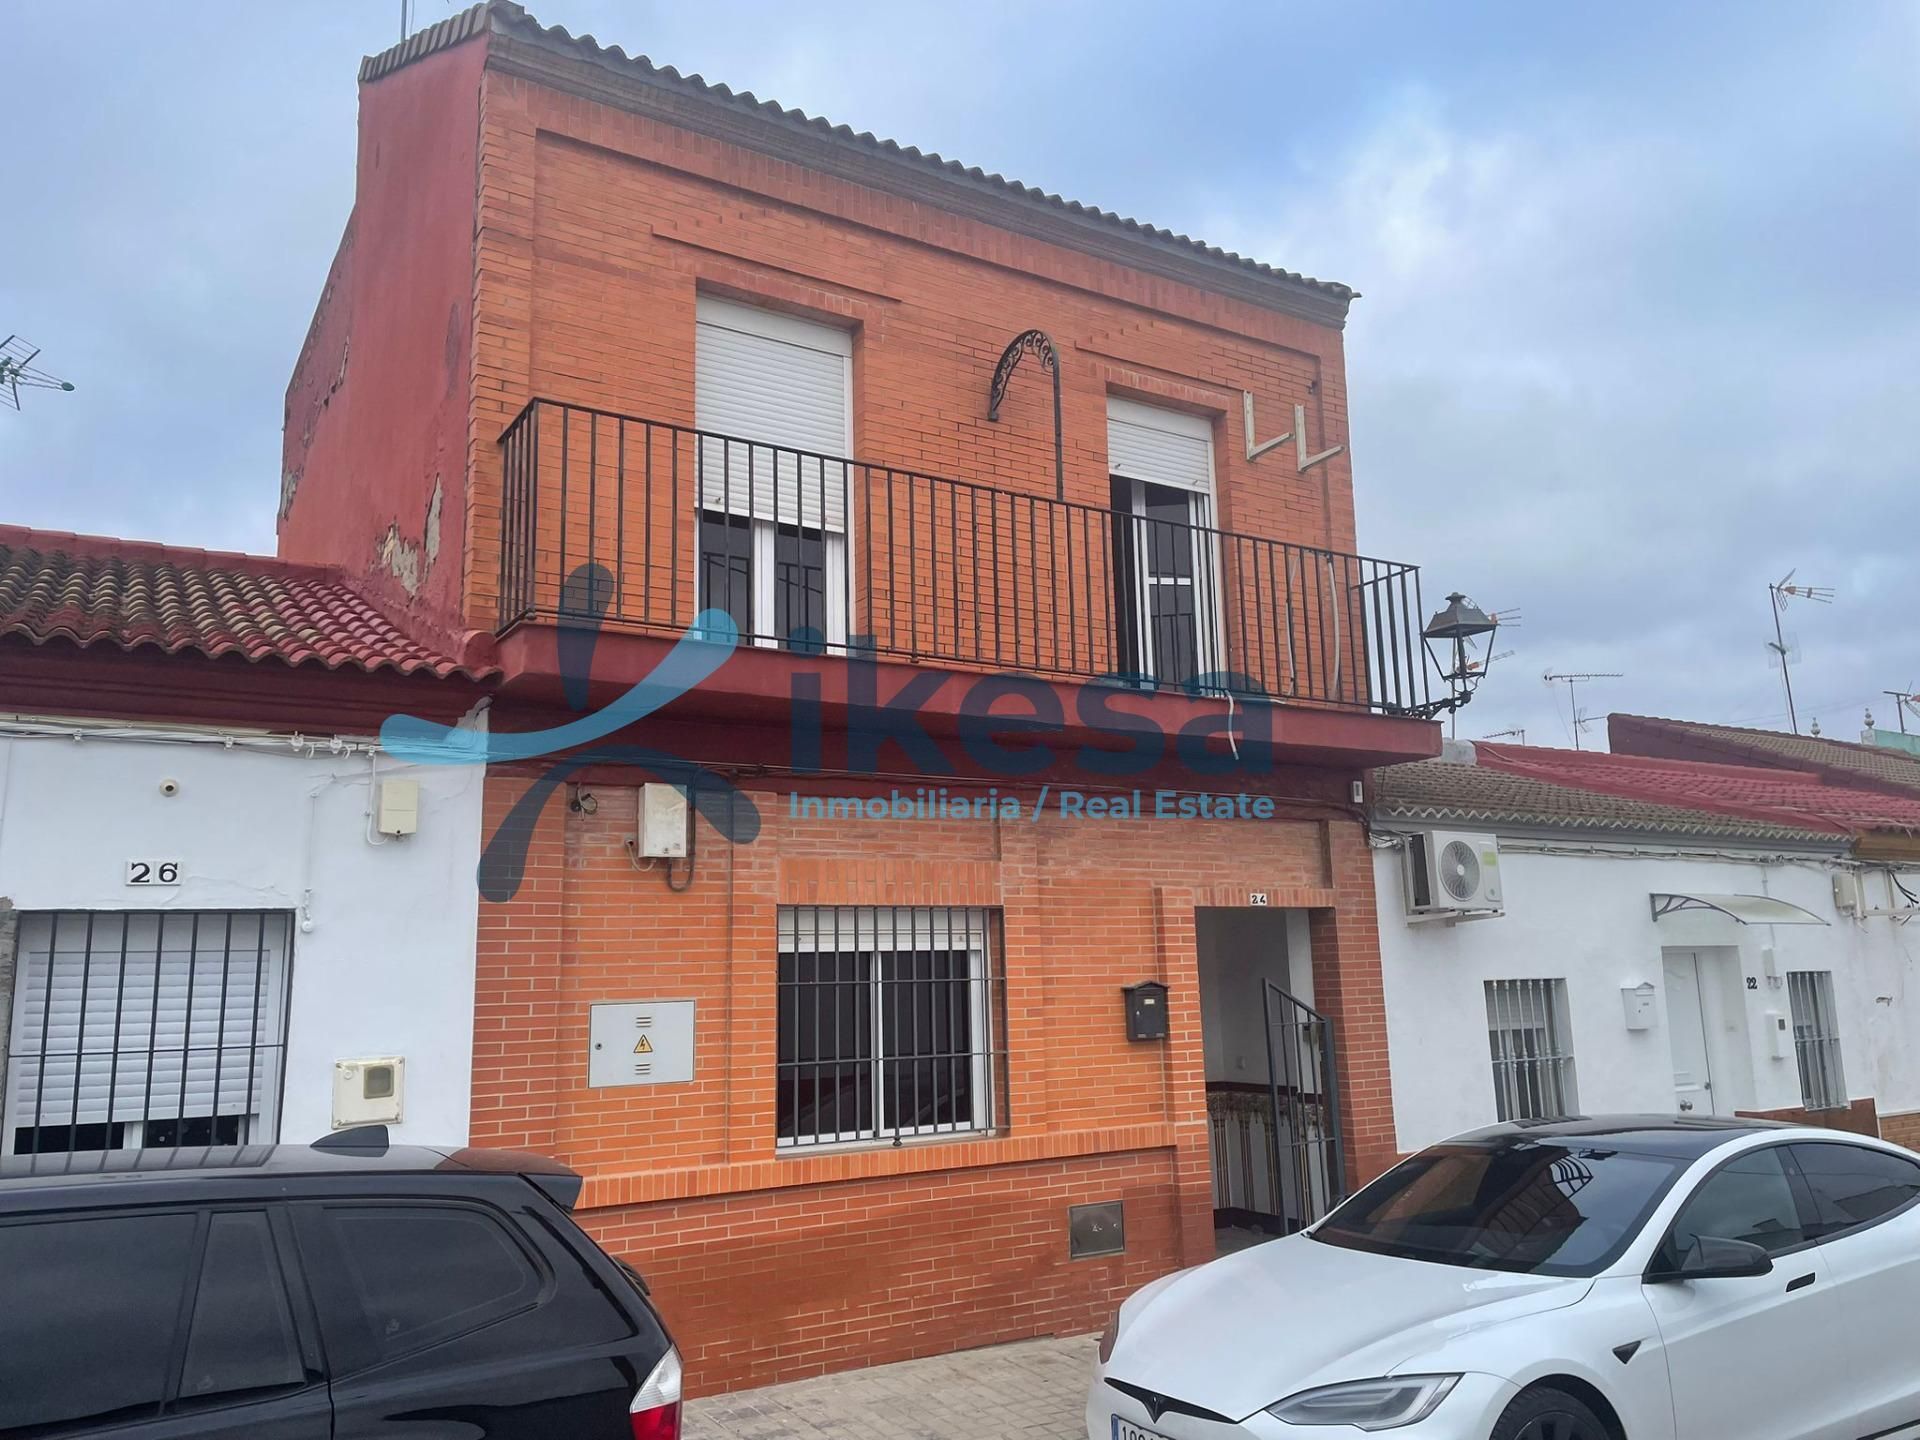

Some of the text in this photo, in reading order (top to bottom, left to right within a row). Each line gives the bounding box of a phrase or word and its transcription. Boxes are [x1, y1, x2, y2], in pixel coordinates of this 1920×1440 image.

[130, 862, 178, 883] 26
[1251, 894, 1266, 905] 24
[1746, 976, 1758, 990] 22
